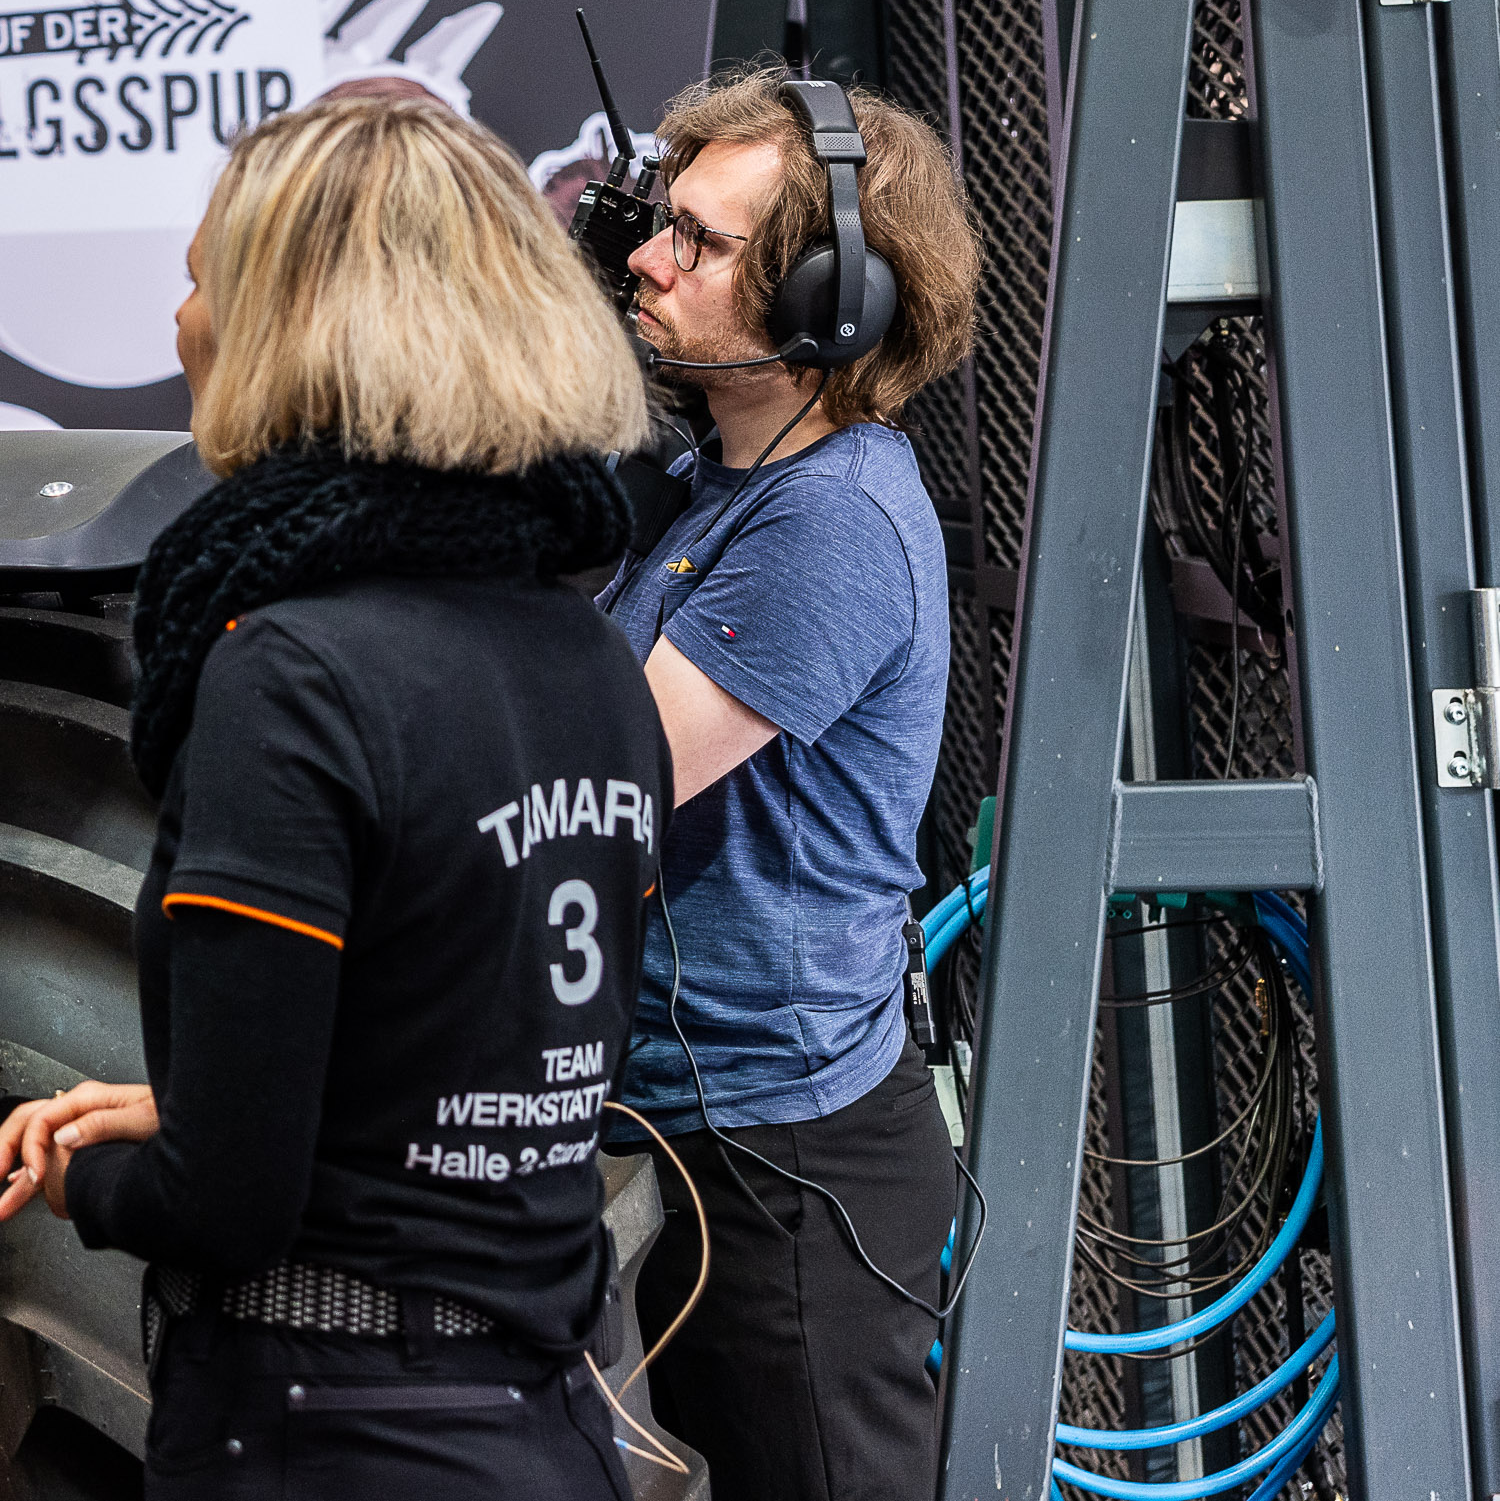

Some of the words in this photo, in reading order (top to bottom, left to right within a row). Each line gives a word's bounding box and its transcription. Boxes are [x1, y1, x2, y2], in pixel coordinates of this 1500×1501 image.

[43, 7, 128, 50] DER
[547, 879, 603, 1006] 3
[542, 1041, 603, 1083] TEAM
[405, 1143, 511, 1182] Halle
